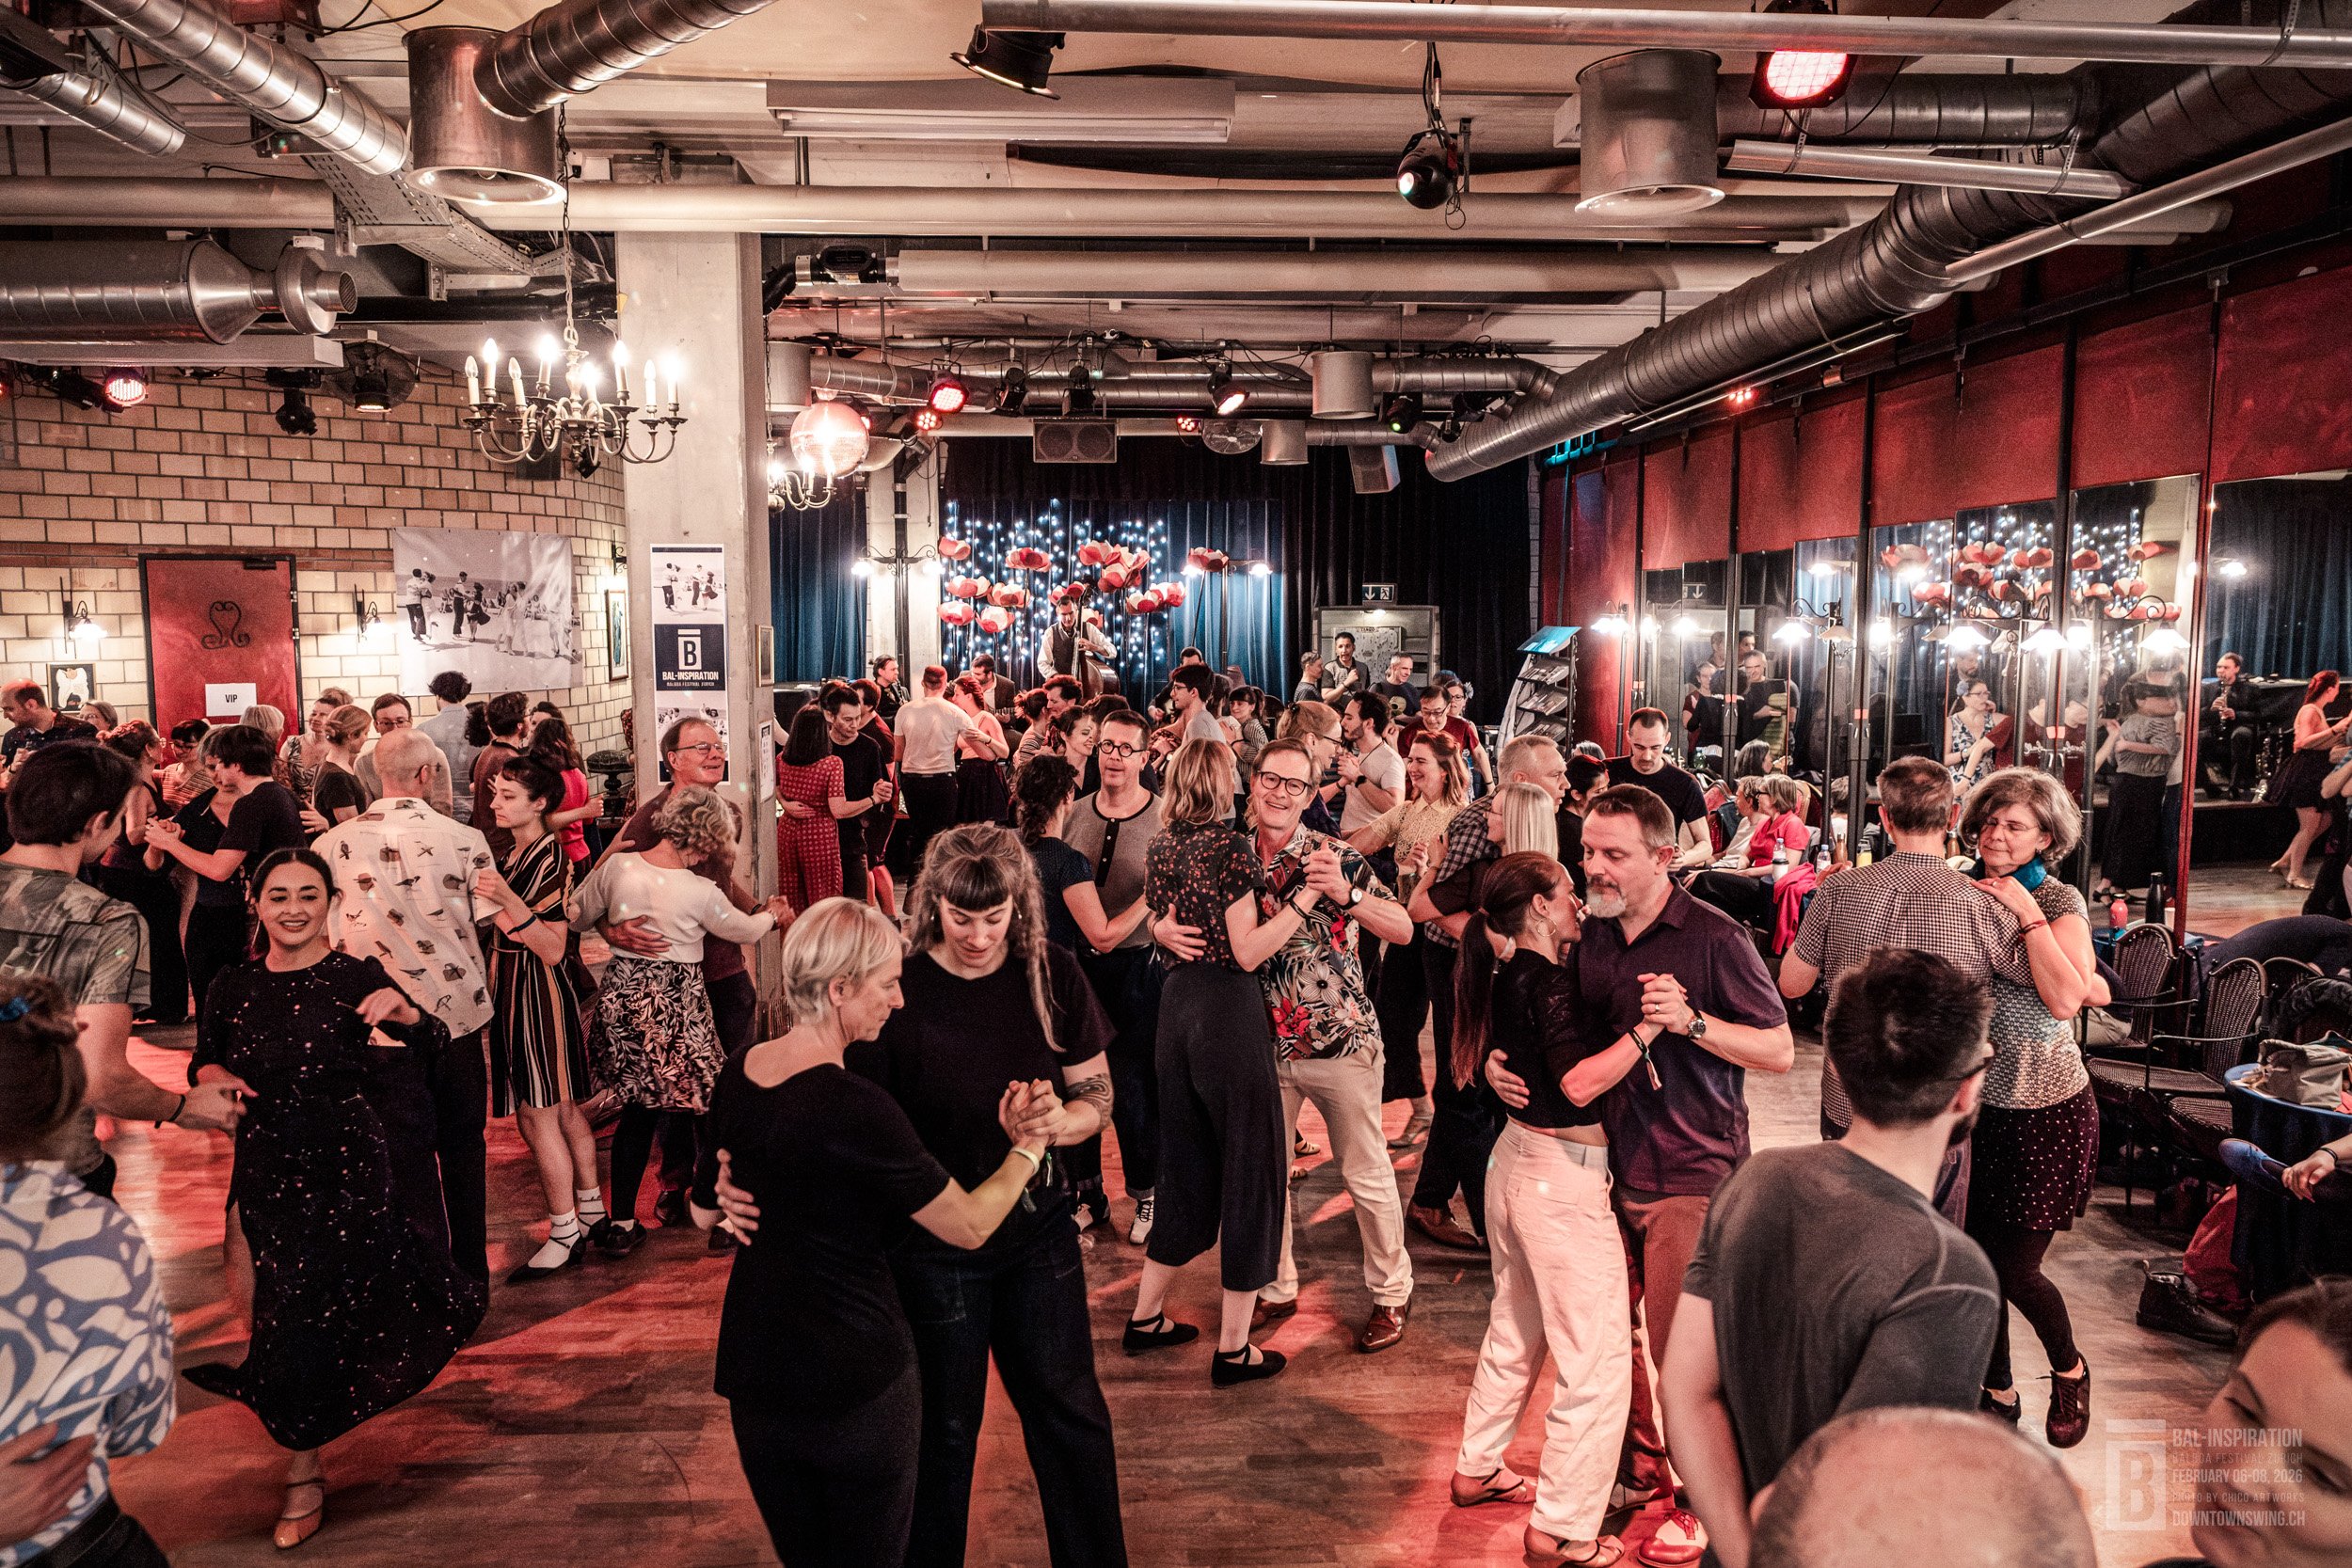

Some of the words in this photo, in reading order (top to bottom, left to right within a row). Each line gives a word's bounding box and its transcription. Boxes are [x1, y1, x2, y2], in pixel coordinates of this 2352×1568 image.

[683, 641, 697, 666] B
[662, 671, 719, 681] BAL-INSPIRATION
[225, 693, 238, 704] VIP
